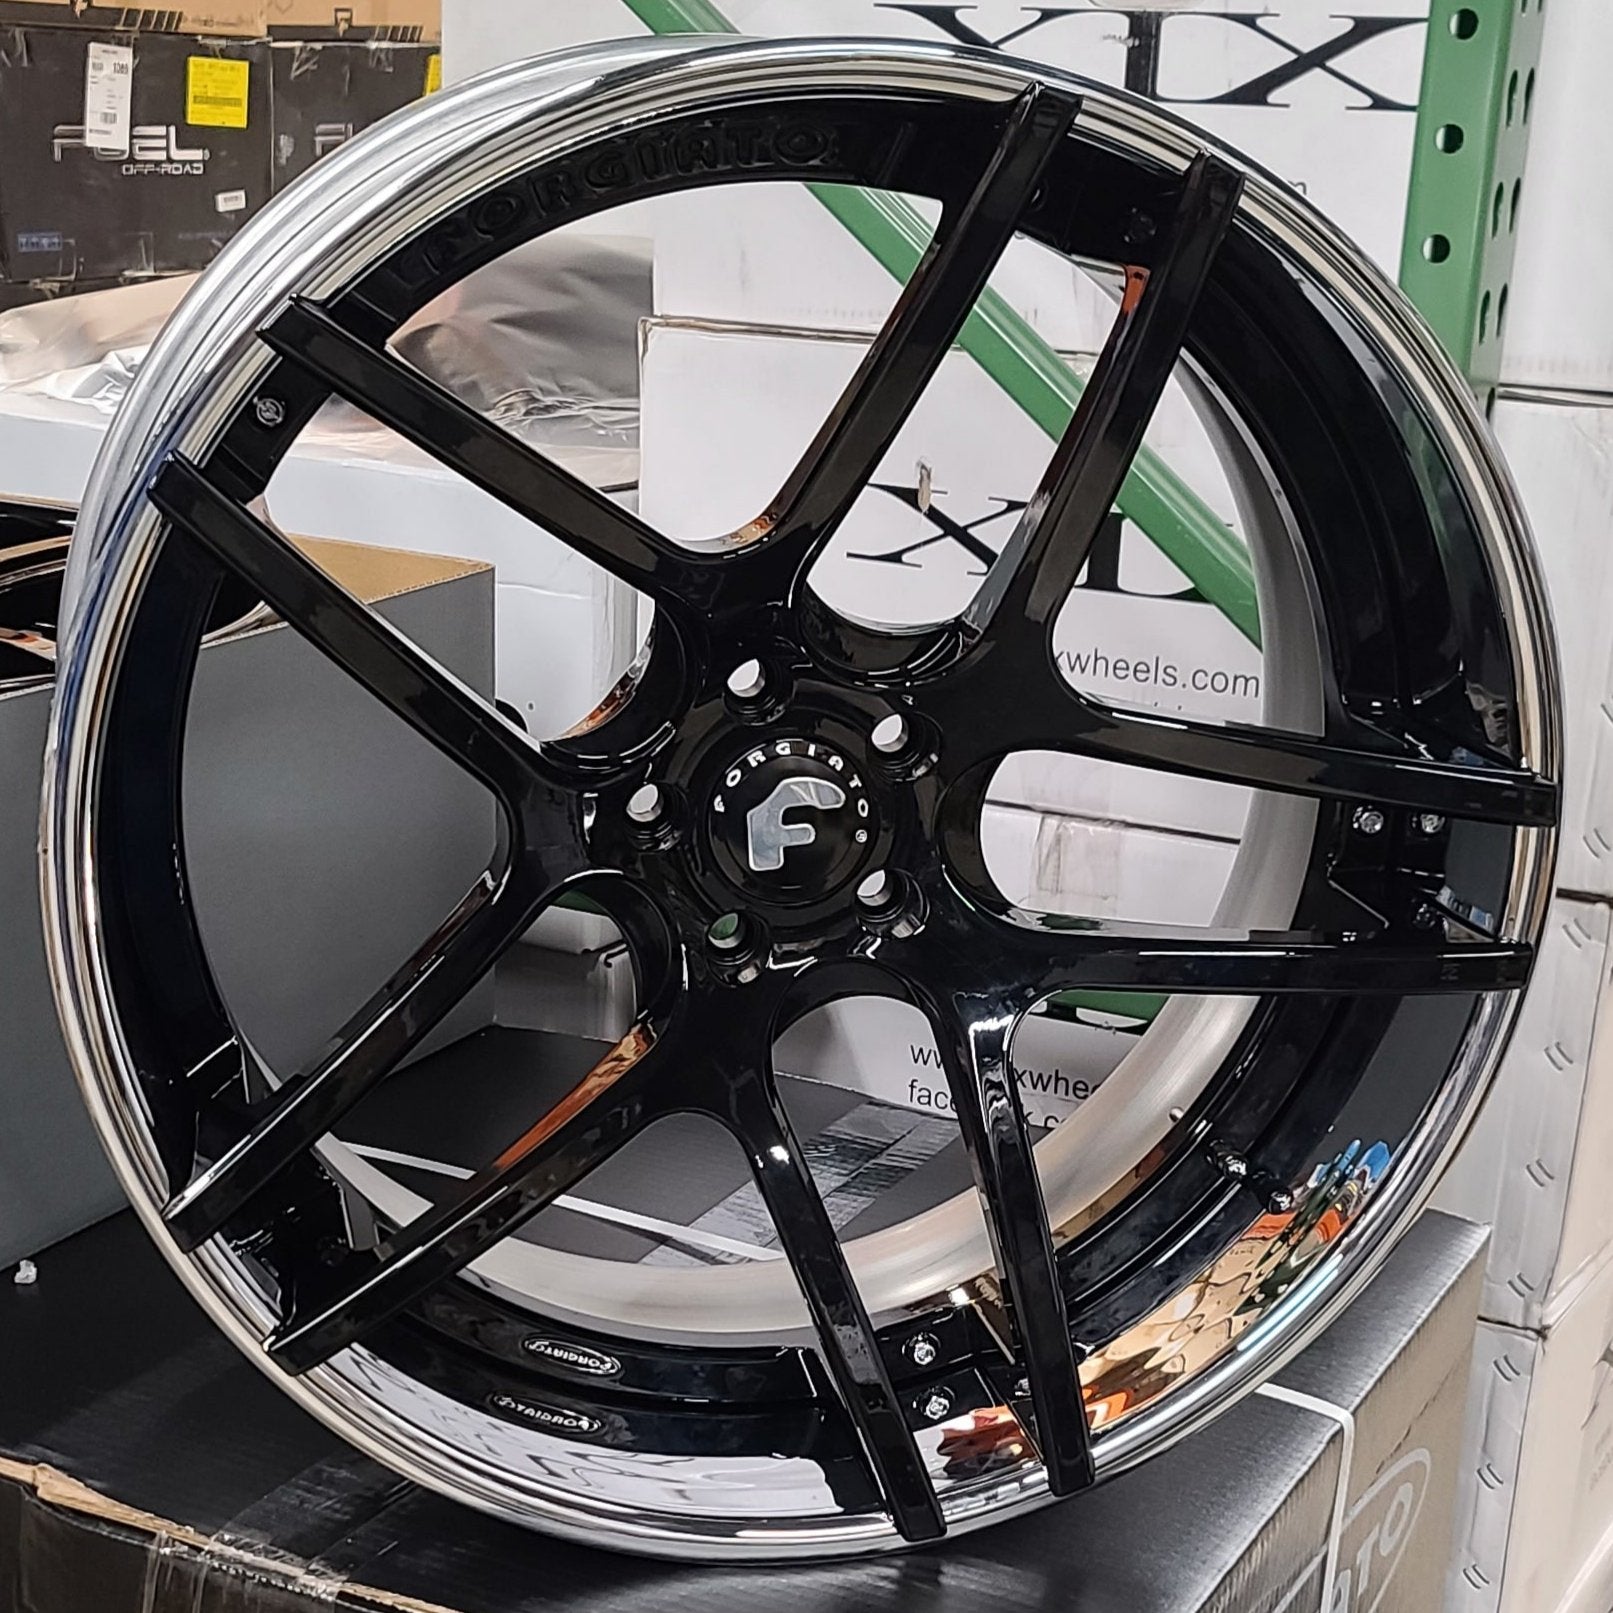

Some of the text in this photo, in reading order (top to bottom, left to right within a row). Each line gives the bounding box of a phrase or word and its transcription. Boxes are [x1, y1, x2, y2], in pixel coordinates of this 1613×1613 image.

[53, 125, 204, 162] FEL
[122, 163, 204, 175] OFF-ROAD
[420, 118, 832, 276] FORGIATO
[713, 743, 869, 818] FORGIATO
